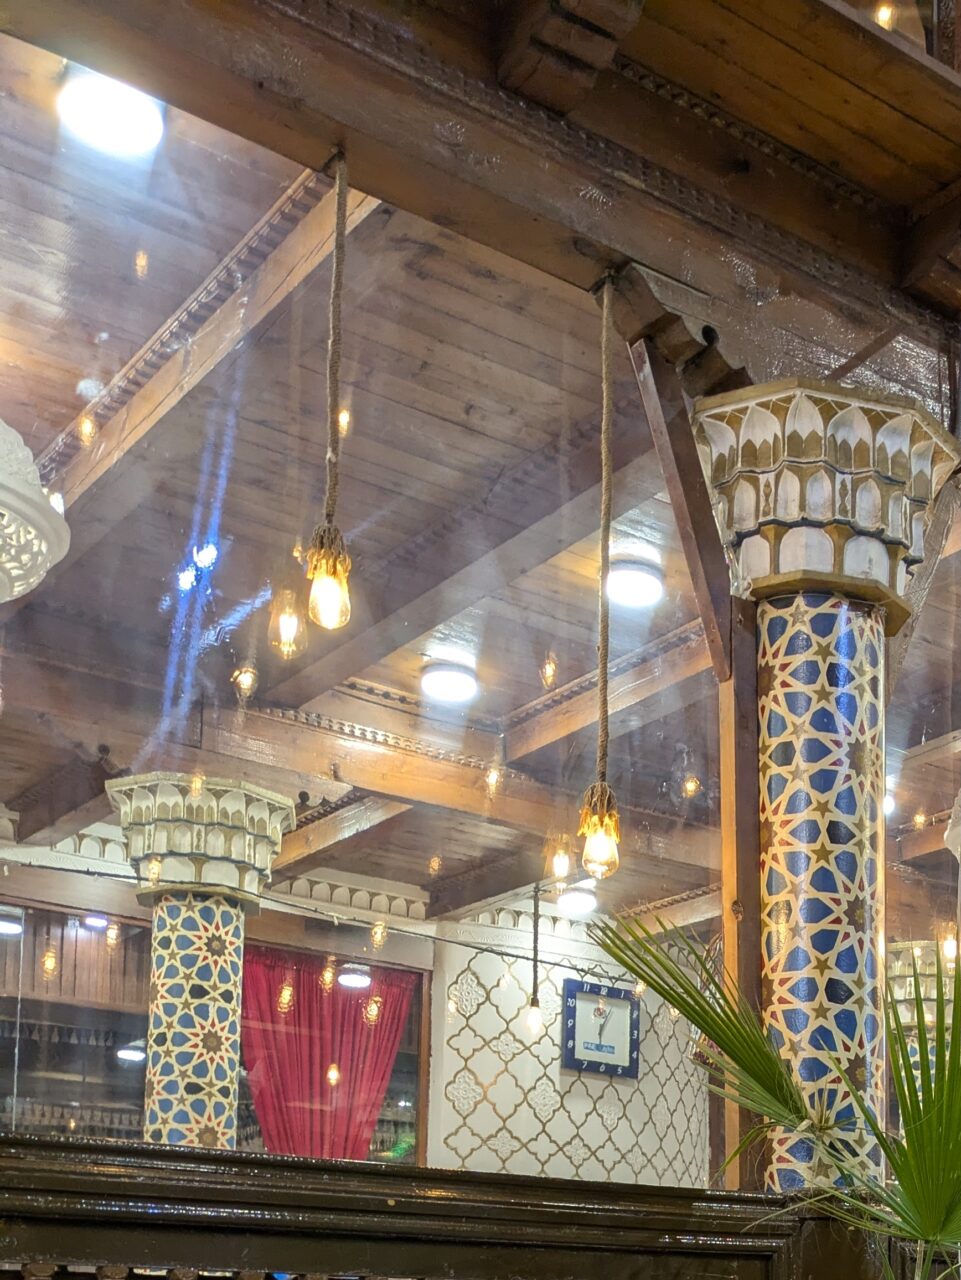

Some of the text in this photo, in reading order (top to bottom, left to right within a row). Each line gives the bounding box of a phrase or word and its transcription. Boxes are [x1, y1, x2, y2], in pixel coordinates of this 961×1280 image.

[583, 984, 590, 992] 11
[567, 998, 575, 1007] 10
[567, 1019, 573, 1028] 9
[632, 1030, 637, 1039] 3
[567, 1040, 573, 1048] 8
[632, 1051, 637, 1059] 4
[582, 1061, 587, 1069] 7
[600, 1064, 605, 1072] 6
